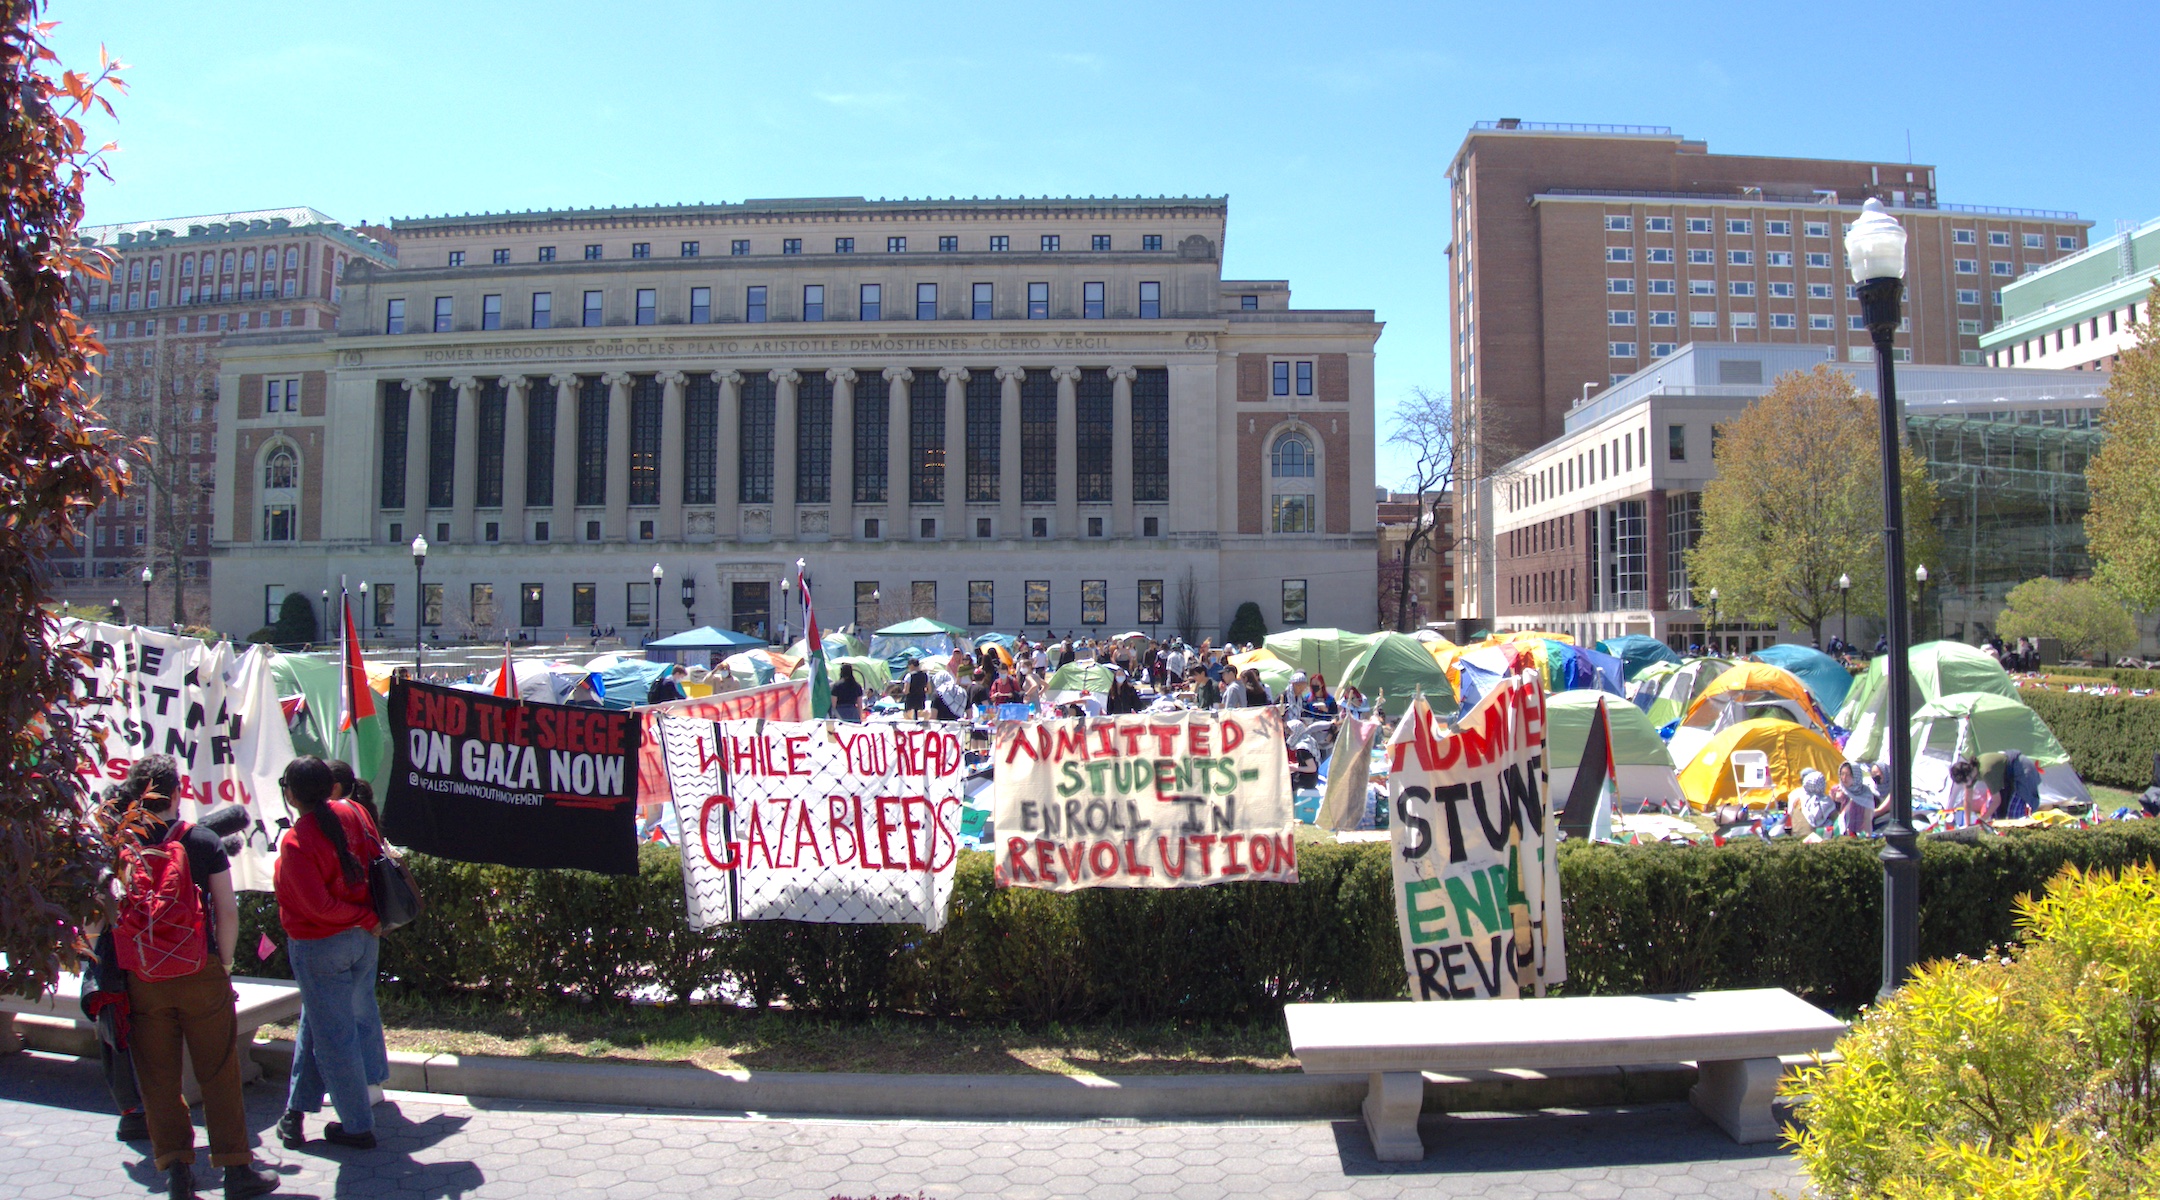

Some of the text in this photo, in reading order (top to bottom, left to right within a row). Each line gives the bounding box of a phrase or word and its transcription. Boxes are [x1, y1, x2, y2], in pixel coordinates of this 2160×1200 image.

[424, 337, 1111, 362] HOMER HERODOTUS SOPHOCLES PLATO ARISTOTLE DEMOSTHENES CICERO VERGIL
[406, 686, 626, 754] END THE SIEGE
[1005, 719, 1245, 764] ADMITTED
[409, 728, 452, 775] ON
[461, 738, 541, 790] GAZA
[550, 748, 625, 796] NOW
[696, 735, 812, 777] WHILE
[833, 731, 887, 776] YOU
[894, 730, 960, 777] READ
[1056, 755, 1259, 802] STUDENTS-
[1020, 794, 1235, 839] ENROLL IN
[1006, 833, 1296, 883] REVOLUTION
